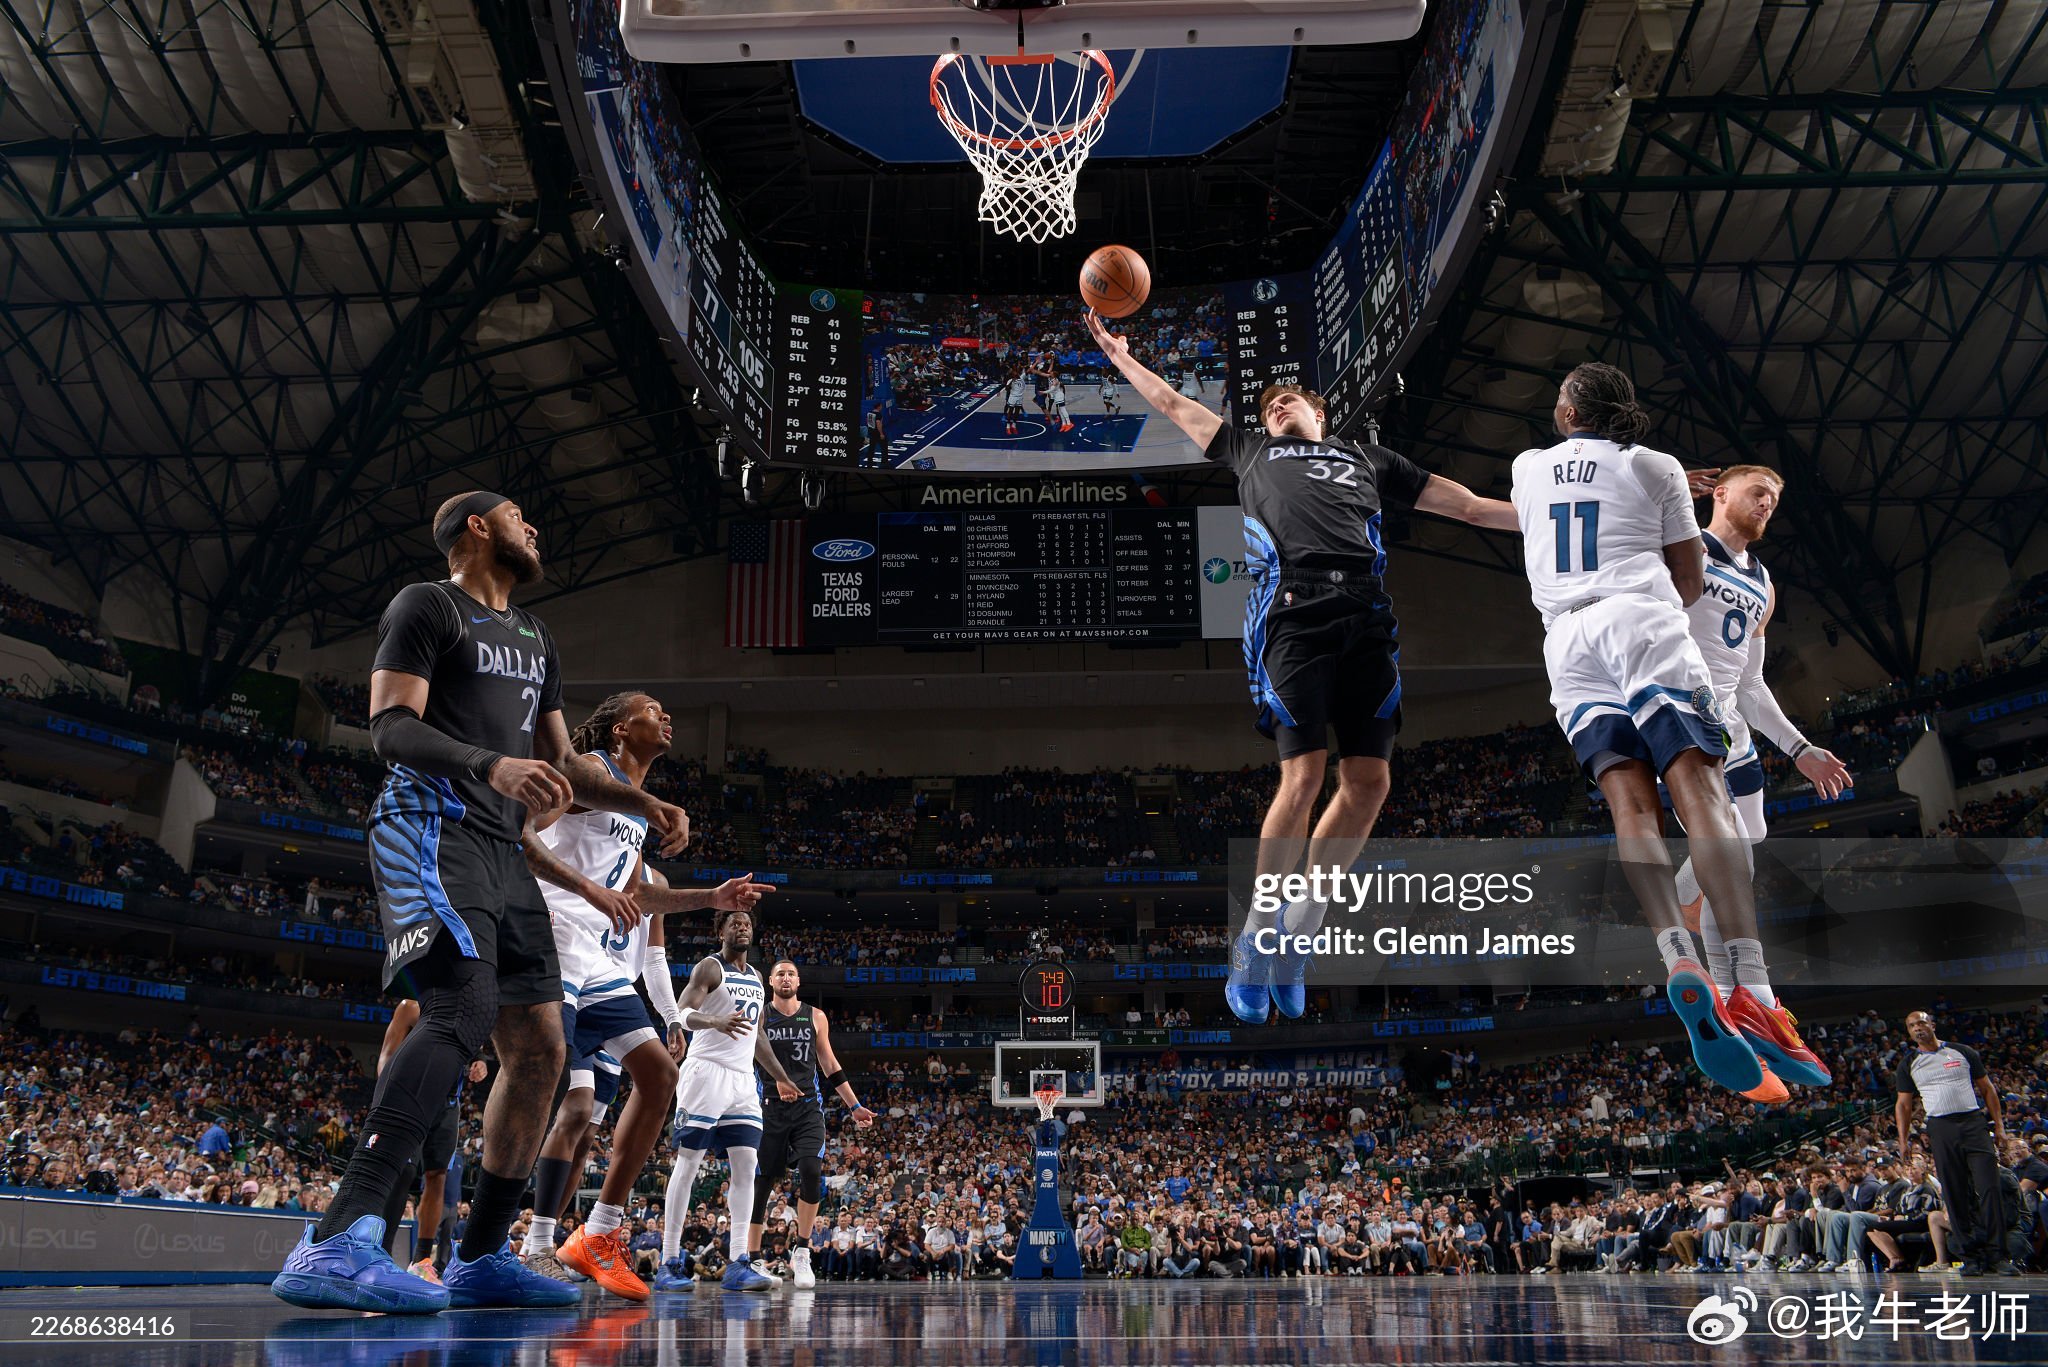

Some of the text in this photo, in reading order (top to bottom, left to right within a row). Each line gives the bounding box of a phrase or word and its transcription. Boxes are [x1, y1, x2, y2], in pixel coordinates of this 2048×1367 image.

[1371, 257, 1396, 314] 105
[704, 278, 719, 323] 77
[791, 314, 840, 328] REB 41
[1237, 306, 1287, 320] REB 43
[1237, 319, 1288, 333] TO 12
[1384, 314, 1394, 333] TOL
[790, 328, 840, 340] TO 10
[1238, 332, 1286, 346] BLK 3
[790, 340, 808, 350] BLK
[1239, 345, 1287, 358] STL 6
[1332, 328, 1350, 372] 77
[1385, 335, 1396, 357] FLS
[739, 340, 764, 389] 105
[789, 353, 836, 365] STL 7
[1354, 335, 1378, 382] 7:43
[717, 347, 739, 394] 7:43
[1241, 362, 1300, 378] FG 27/75
[788, 372, 847, 385] FG 42/78
[1242, 381, 1263, 391] 3-PT
[788, 385, 847, 398] 3-PT 13/26
[1242, 395, 1254, 404] FT
[1330, 390, 1340, 408] TOL
[787, 398, 843, 410] FT 8/12
[786, 418, 847, 431] FG 53.8%
[1244, 415, 1257, 423] FG
[1332, 410, 1342, 429] FLS
[786, 431, 847, 444] 3-PT 50.0%
[786, 444, 847, 457] FT 66.7%
[1267, 445, 1354, 462] DALLAS
[1305, 459, 1357, 487] 32
[1553, 460, 1598, 486] REID
[921, 483, 1127, 505] American Airlines
[1549, 501, 1600, 574] 11
[824, 542, 862, 558] Ford
[1233, 561, 1249, 573] TX
[822, 572, 863, 586] TEXAS
[825, 588, 859, 601] FORD
[1703, 579, 1764, 622] WOLVE
[812, 604, 871, 617] DEALERS
[1074, 629, 1149, 637] MAVSSHOP.COM
[1722, 609, 1747, 648] 0
[476, 641, 546, 686] DALLAS
[232, 693, 247, 703] DO
[230, 705, 261, 718] WHAT
[609, 817, 643, 852] WOLVE
[606, 850, 628, 888] 8
[389, 927, 429, 967] MAVS
[41, 966, 100, 990] LET'S
[845, 967, 976, 982] LET'S GO MAVS
[1038, 972, 1065, 984] 7:43
[1113, 964, 1165, 980] LET'S
[1198, 964, 1228, 978] MA
[726, 986, 763, 1000] WOLVES
[1042, 985, 1062, 1007] 10
[735, 999, 759, 1025] 30
[767, 1028, 811, 1040] DALLAS
[791, 1041, 810, 1061] 31
[1224, 1070, 1372, 1087] PROUD & LOUD!
[9, 1227, 96, 1248] LEXUS
[160, 1233, 225, 1253] LEXUS
